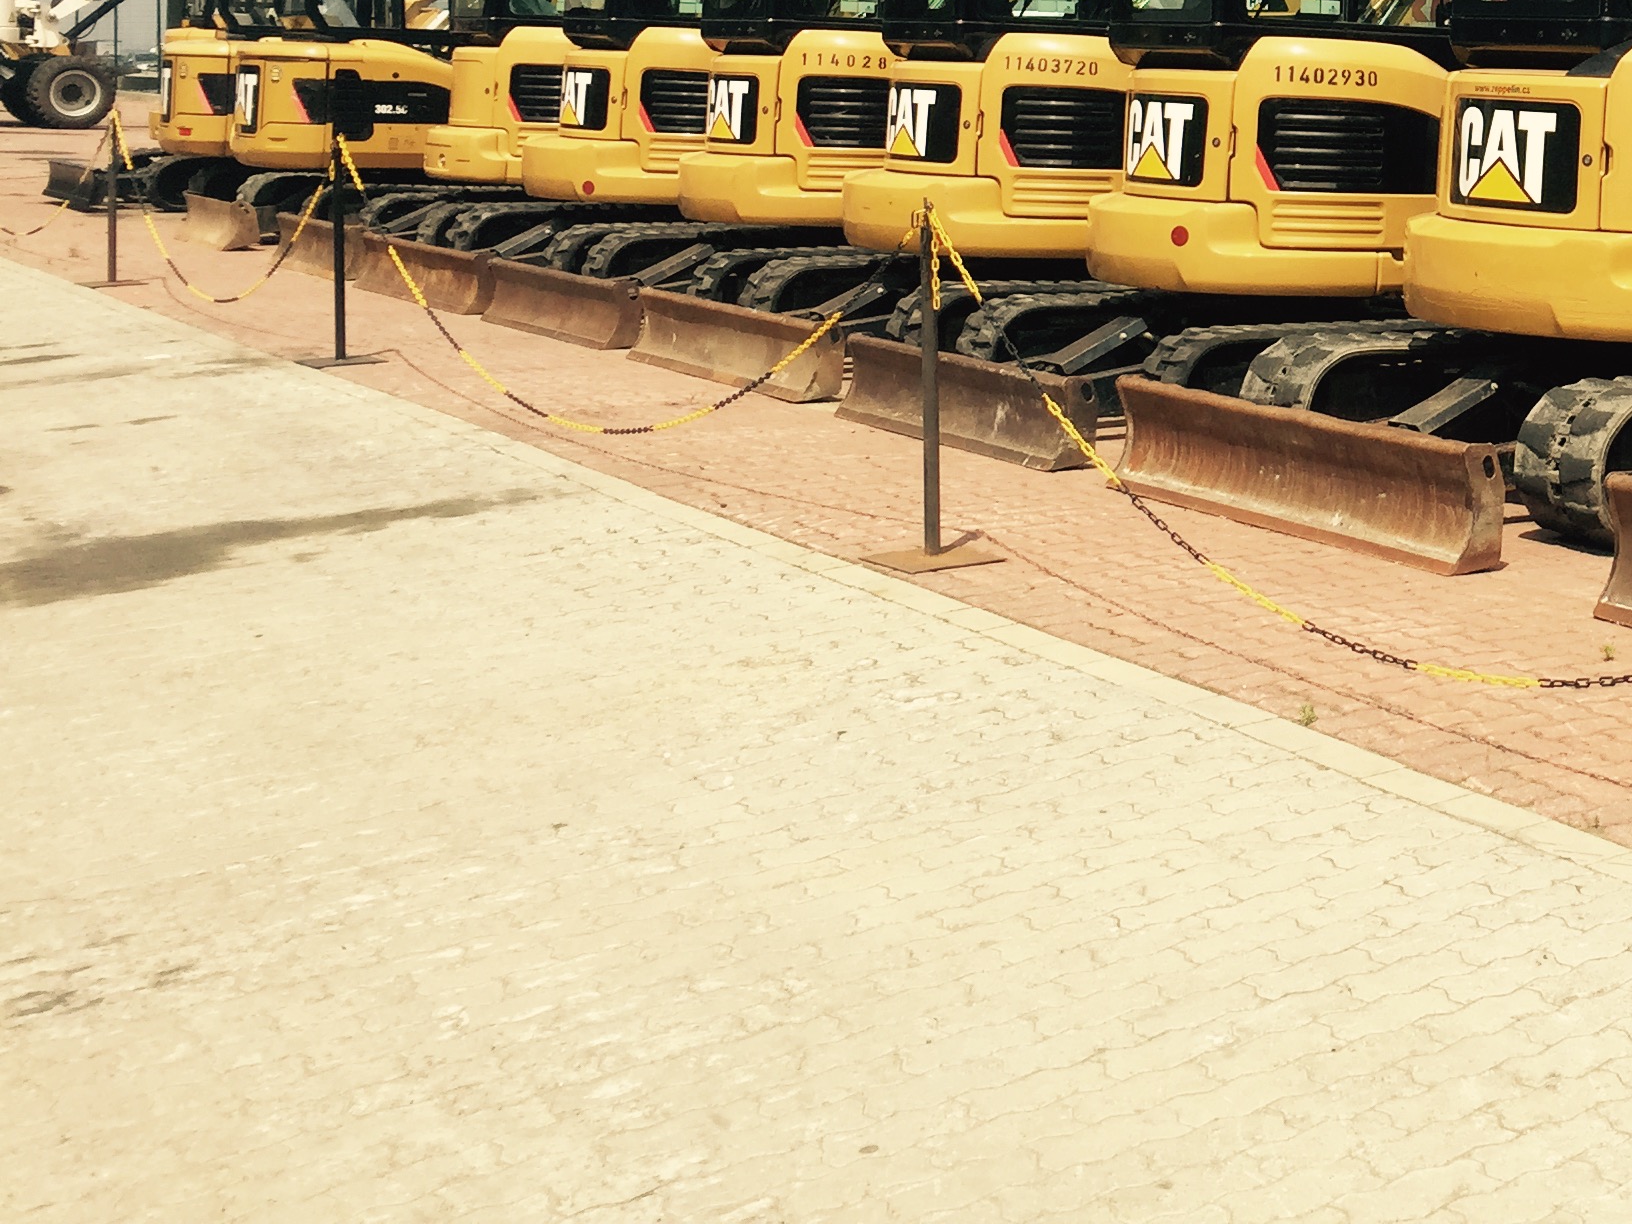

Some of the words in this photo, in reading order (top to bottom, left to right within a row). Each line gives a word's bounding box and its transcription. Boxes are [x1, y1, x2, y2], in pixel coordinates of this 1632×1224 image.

[802, 52, 903, 70] 114028
[1005, 55, 1098, 76] 11403720
[1274, 65, 1378, 87] 11402930
[234, 72, 258, 126] AT
[1127, 99, 1194, 180] CAT
[1459, 106, 1557, 204] CAT
